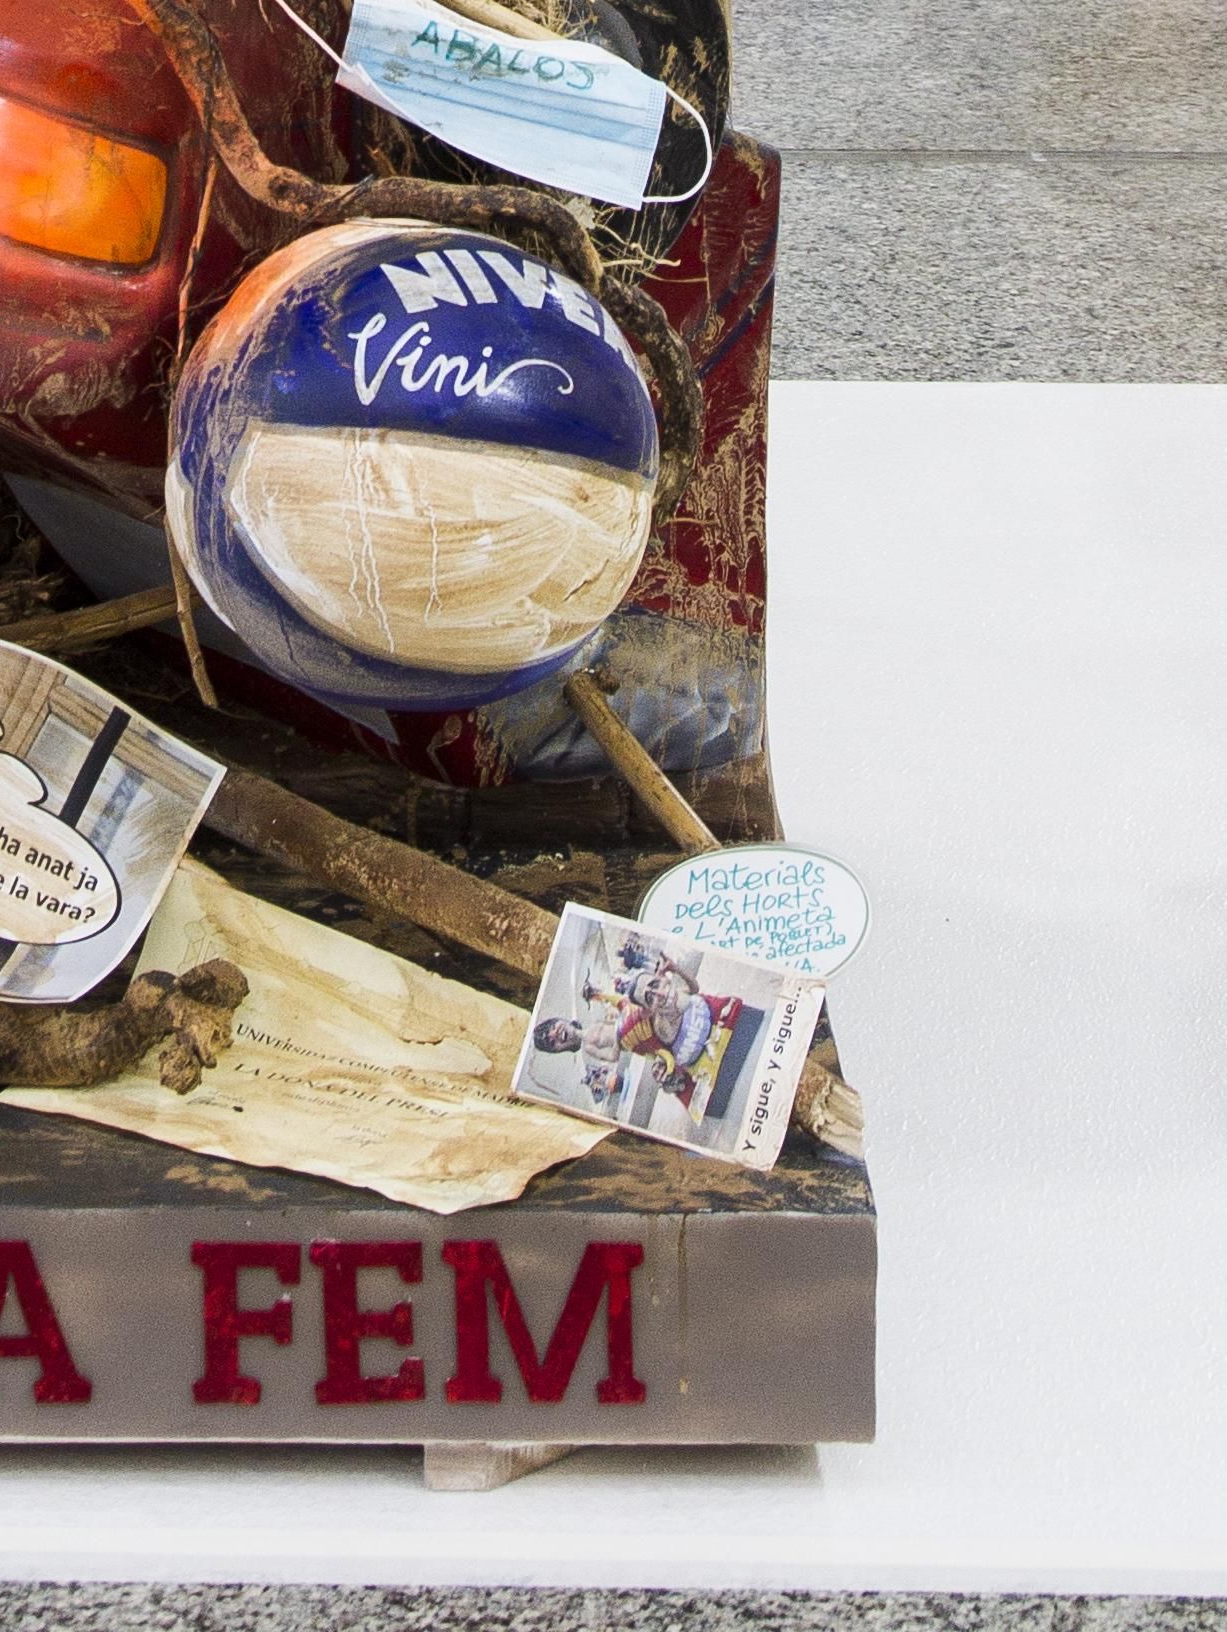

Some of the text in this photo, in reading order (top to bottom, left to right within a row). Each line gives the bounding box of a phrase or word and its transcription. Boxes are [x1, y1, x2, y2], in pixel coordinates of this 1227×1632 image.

[411, 20, 594, 90] ABALOS
[348, 313, 574, 406] Vini
[9, 876, 29, 901] la
[36, 890, 96, 924] vara?
[24, 846, 74, 881] anat
[73, 867, 99, 892] ja
[687, 860, 825, 895] Materials
[742, 1139, 757, 1151] Y
[750, 1079, 776, 1136] sigue,
[768, 1058, 781, 1071] y
[190, 1236, 647, 1406] FEM
